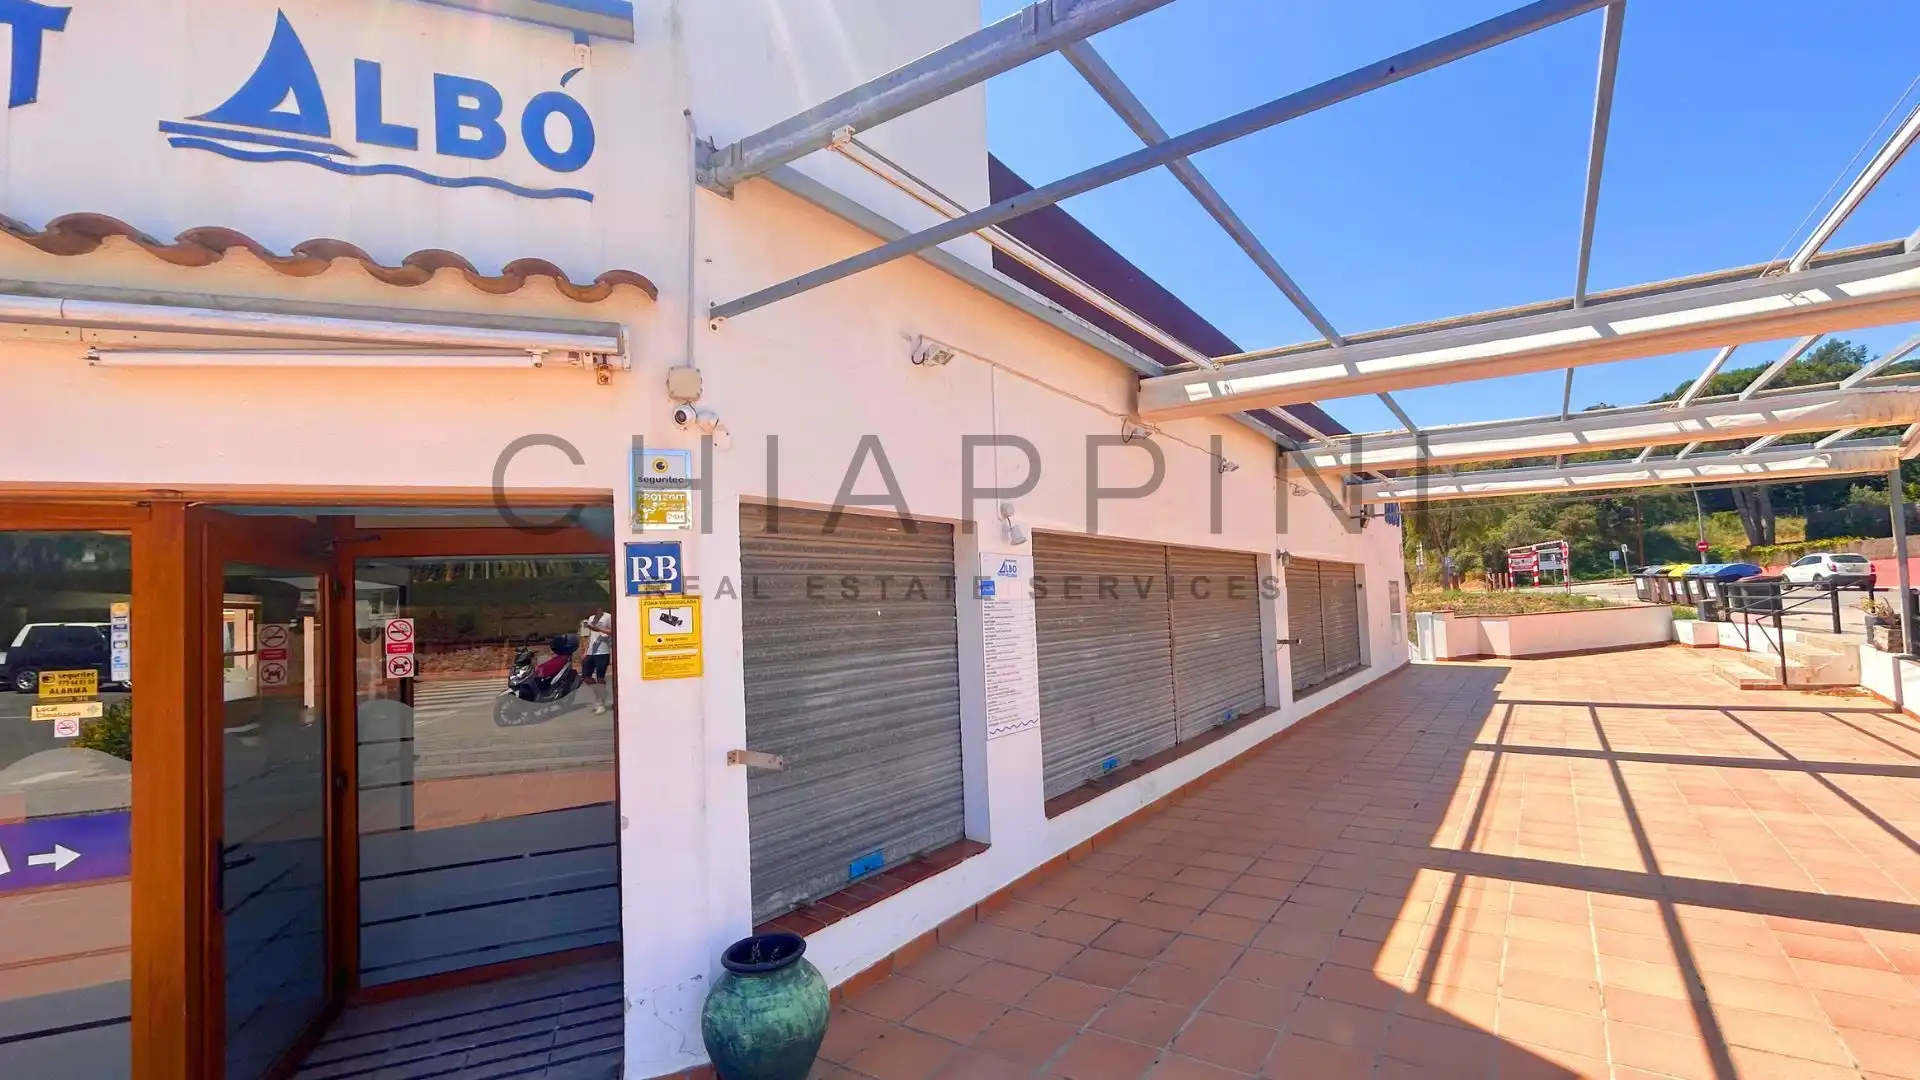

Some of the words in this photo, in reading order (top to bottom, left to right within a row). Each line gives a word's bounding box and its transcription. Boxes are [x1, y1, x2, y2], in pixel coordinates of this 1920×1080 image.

[637, 475, 684, 485] seguritec
[629, 555, 679, 583] RB
[49, 687, 87, 695] ALARMA
